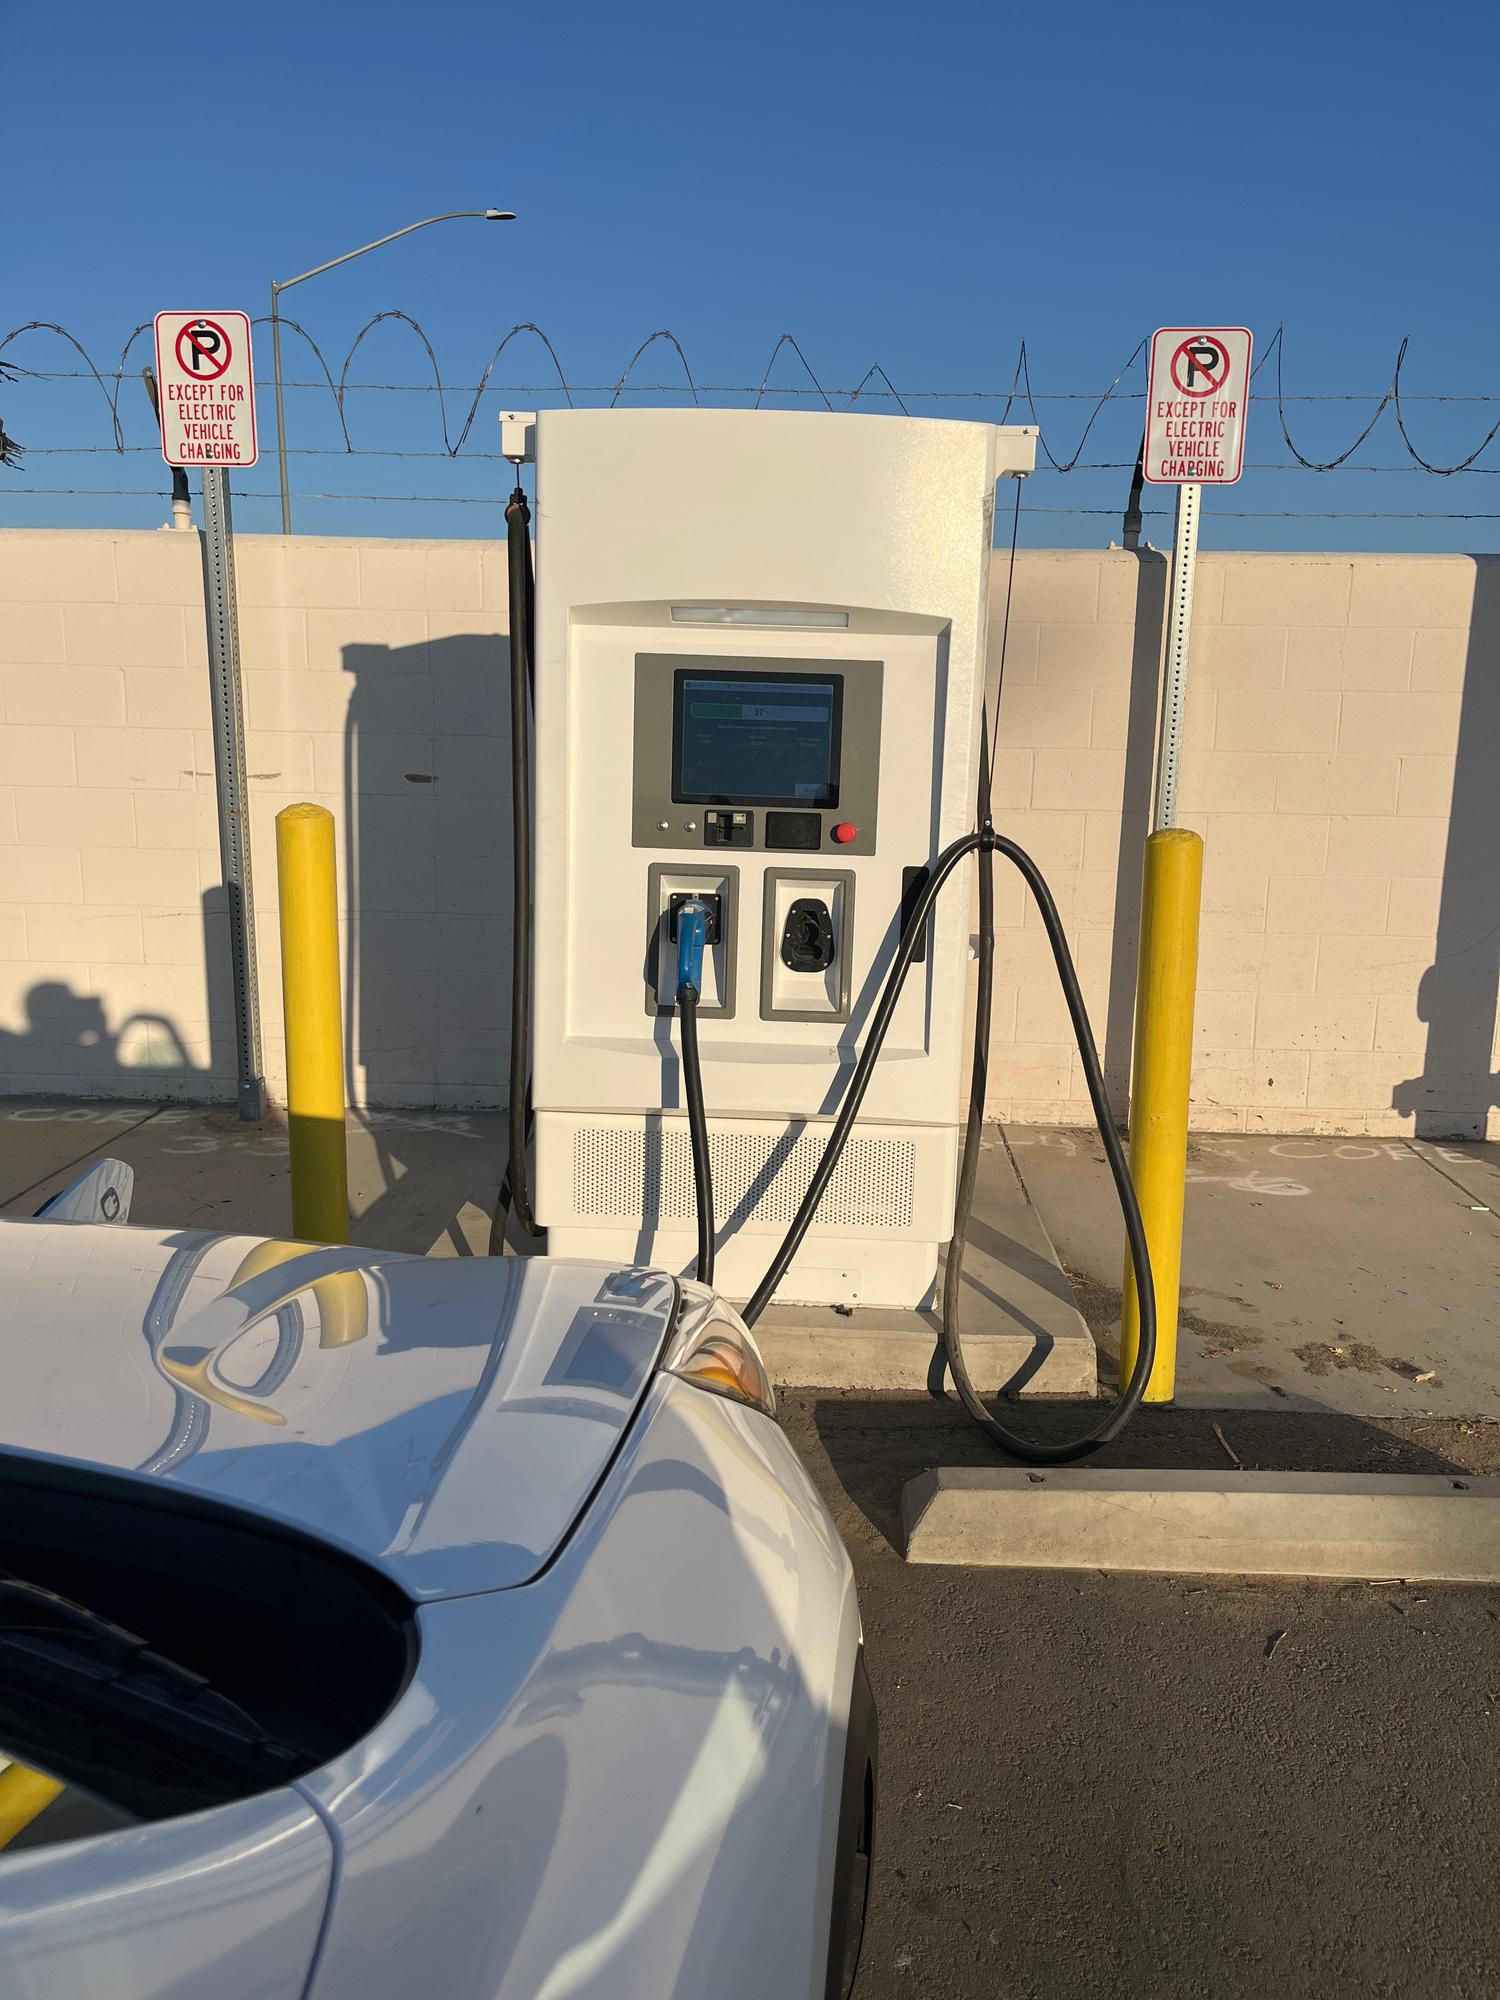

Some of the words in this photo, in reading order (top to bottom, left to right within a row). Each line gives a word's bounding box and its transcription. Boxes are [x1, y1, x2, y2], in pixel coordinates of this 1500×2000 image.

[168, 384, 214, 401] EXCEPT
[221, 384, 244, 401] FOR
[179, 404, 236, 421] ELECTRIC
[1157, 401, 1205, 418] EXCEPT
[1212, 401, 1236, 418] FOR
[184, 423, 234, 440] VEHICLE
[1166, 421, 1225, 437] ELECTRIC
[1169, 441, 1220, 457] VEHICLE
[7, 1108, 193, 1124] CORE
[1268, 1141, 1484, 1164] CORE
